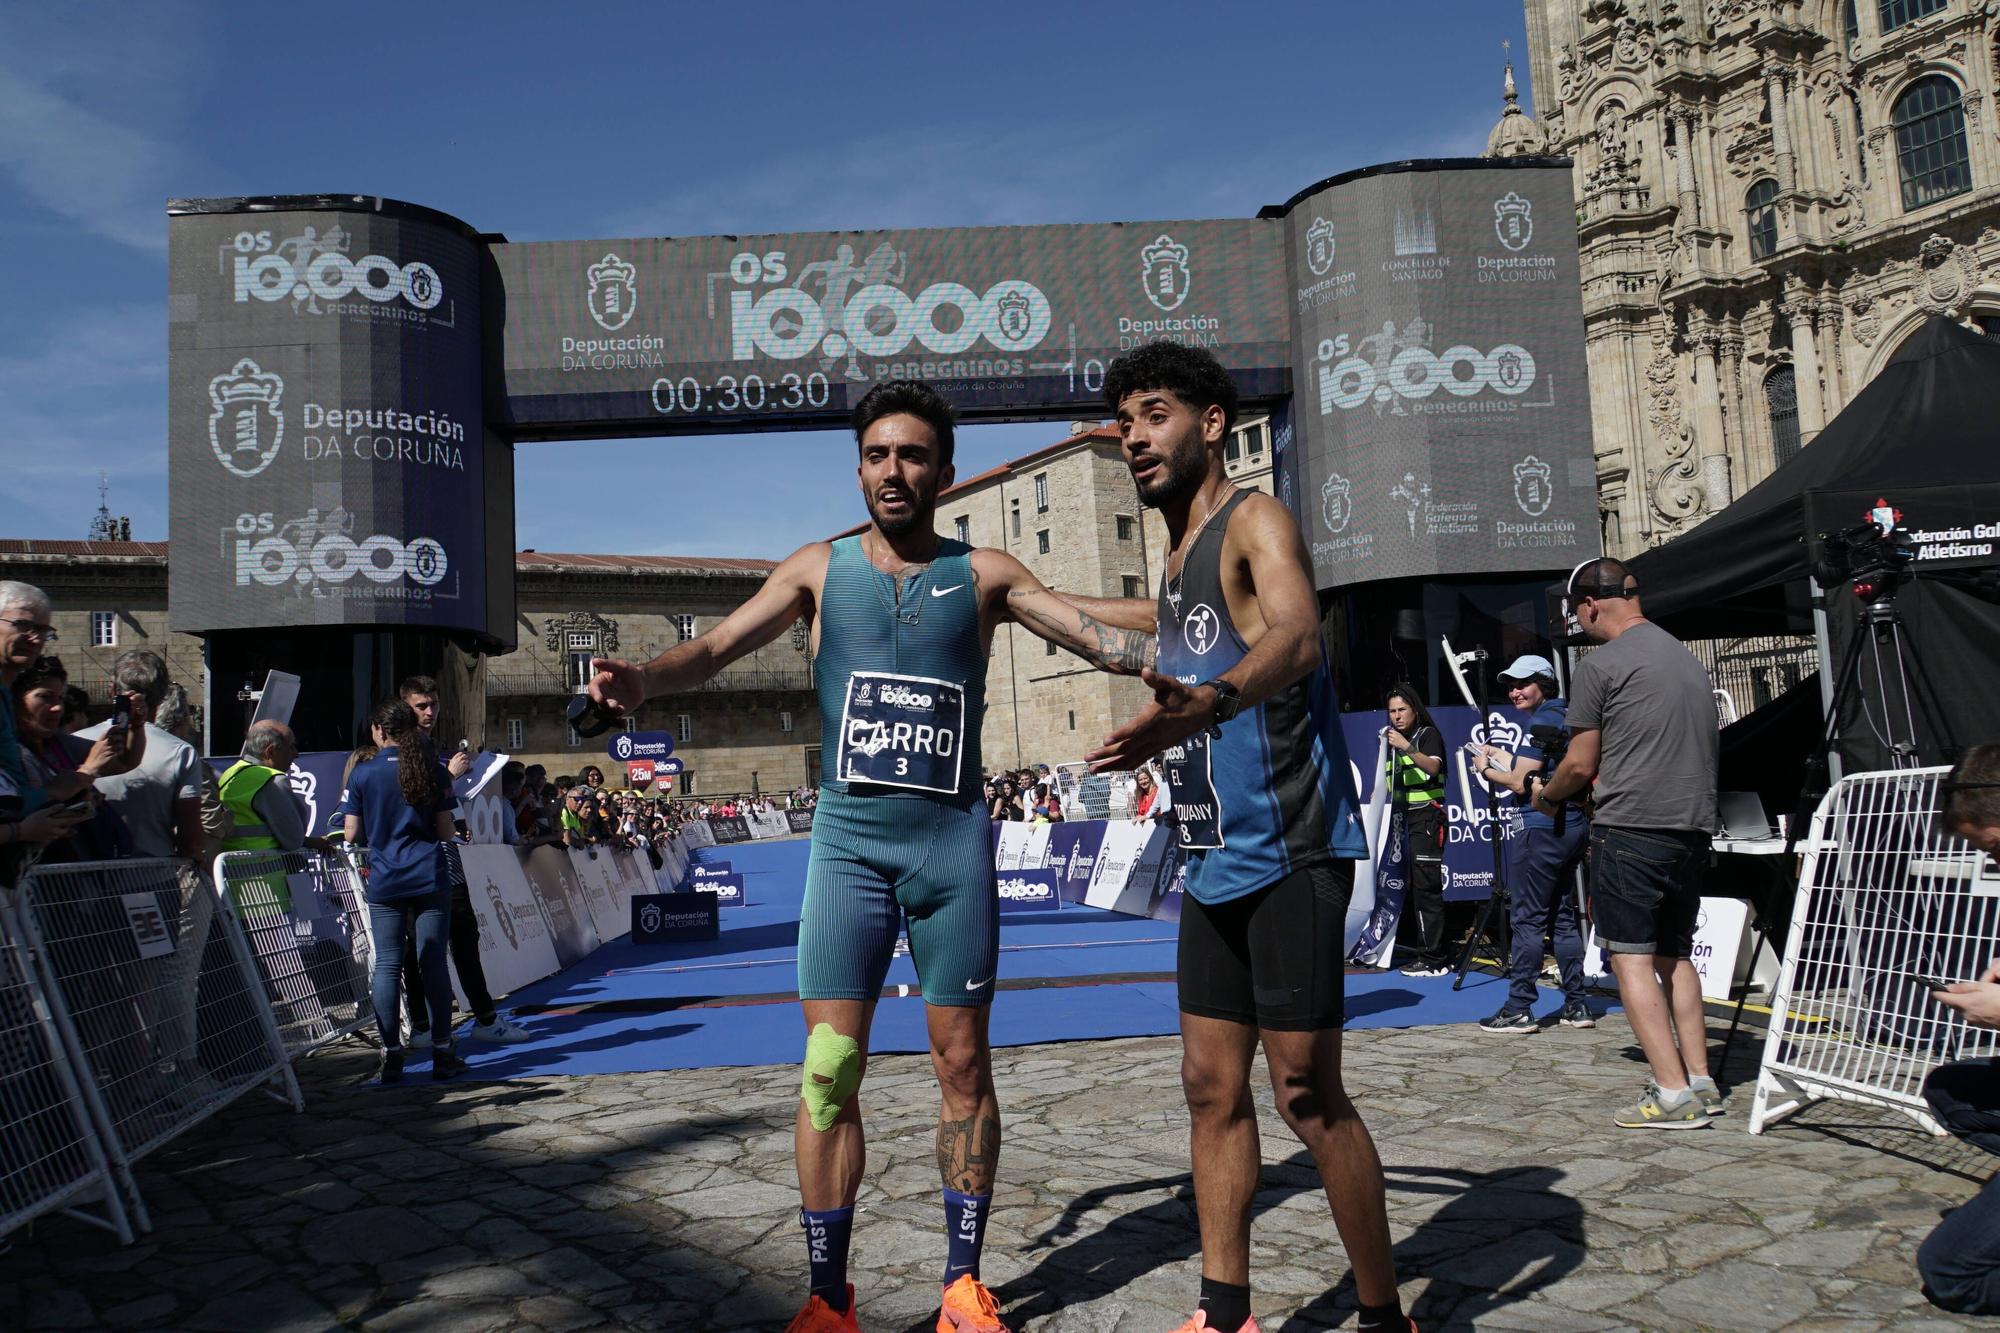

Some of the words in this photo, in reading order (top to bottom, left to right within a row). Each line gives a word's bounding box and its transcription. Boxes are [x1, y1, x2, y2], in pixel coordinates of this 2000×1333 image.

[234, 230, 272, 253] OS
[730, 251, 788, 285] OS
[1382, 257, 1435, 272] CONCELLO
[1438, 256, 1452, 268] DE
[1478, 254, 1556, 273] Deputación
[234, 252, 443, 309] 10.000
[1392, 268, 1443, 283] SANTIAGO
[1478, 270, 1497, 283] DA
[1501, 266, 1557, 282] CORUÑA
[1297, 271, 1356, 302] Deputación
[1311, 284, 1357, 309] CORUÑA
[731, 279, 1051, 361] 10.000
[1118, 314, 1219, 336] Deputación
[562, 334, 664, 355] Deputación
[1119, 336, 1143, 351] DA
[1317, 333, 1350, 363] OS
[562, 355, 586, 371] DA
[591, 351, 664, 371] CORUÑA
[1062, 357, 1114, 393] 10
[1319, 343, 1536, 416] 10.000
[652, 371, 829, 413] 00:30:30
[303, 402, 464, 442] Deputación
[303, 436, 342, 461] DA
[353, 436, 464, 473] CORUÑA
[1424, 501, 1477, 513] Federación
[235, 511, 274, 535] OS
[1425, 523, 1479, 535] Atletismo
[1496, 519, 1576, 535] Deputación
[1312, 532, 1373, 555] Deputación
[1497, 536, 1516, 549] DA
[1519, 534, 1576, 548] CORUÑA
[235, 534, 448, 586] 10.000
[1326, 547, 1374, 566] CORUÑA
[1917, 543, 1992, 561] Atletismo
[633, 742, 666, 750] Deputación
[847, 718, 954, 757] CARRO
[632, 768, 652, 781] 25M
[895, 757, 908, 776] 3
[659, 780, 672, 789] 50M
[1171, 769, 1183, 786] EL
[1180, 823, 1192, 843] 8
[1449, 825, 1475, 843] DA
[1453, 871, 1494, 882] Deputación
[1453, 880, 1463, 888] DA
[1465, 878, 1492, 888] CORUÑ
[664, 911, 709, 922] Deputación
[665, 921, 676, 929] DA
[678, 918, 709, 928] CORUÑA
[958, 1199, 978, 1245] PAST
[808, 1216, 828, 1263] PAST
